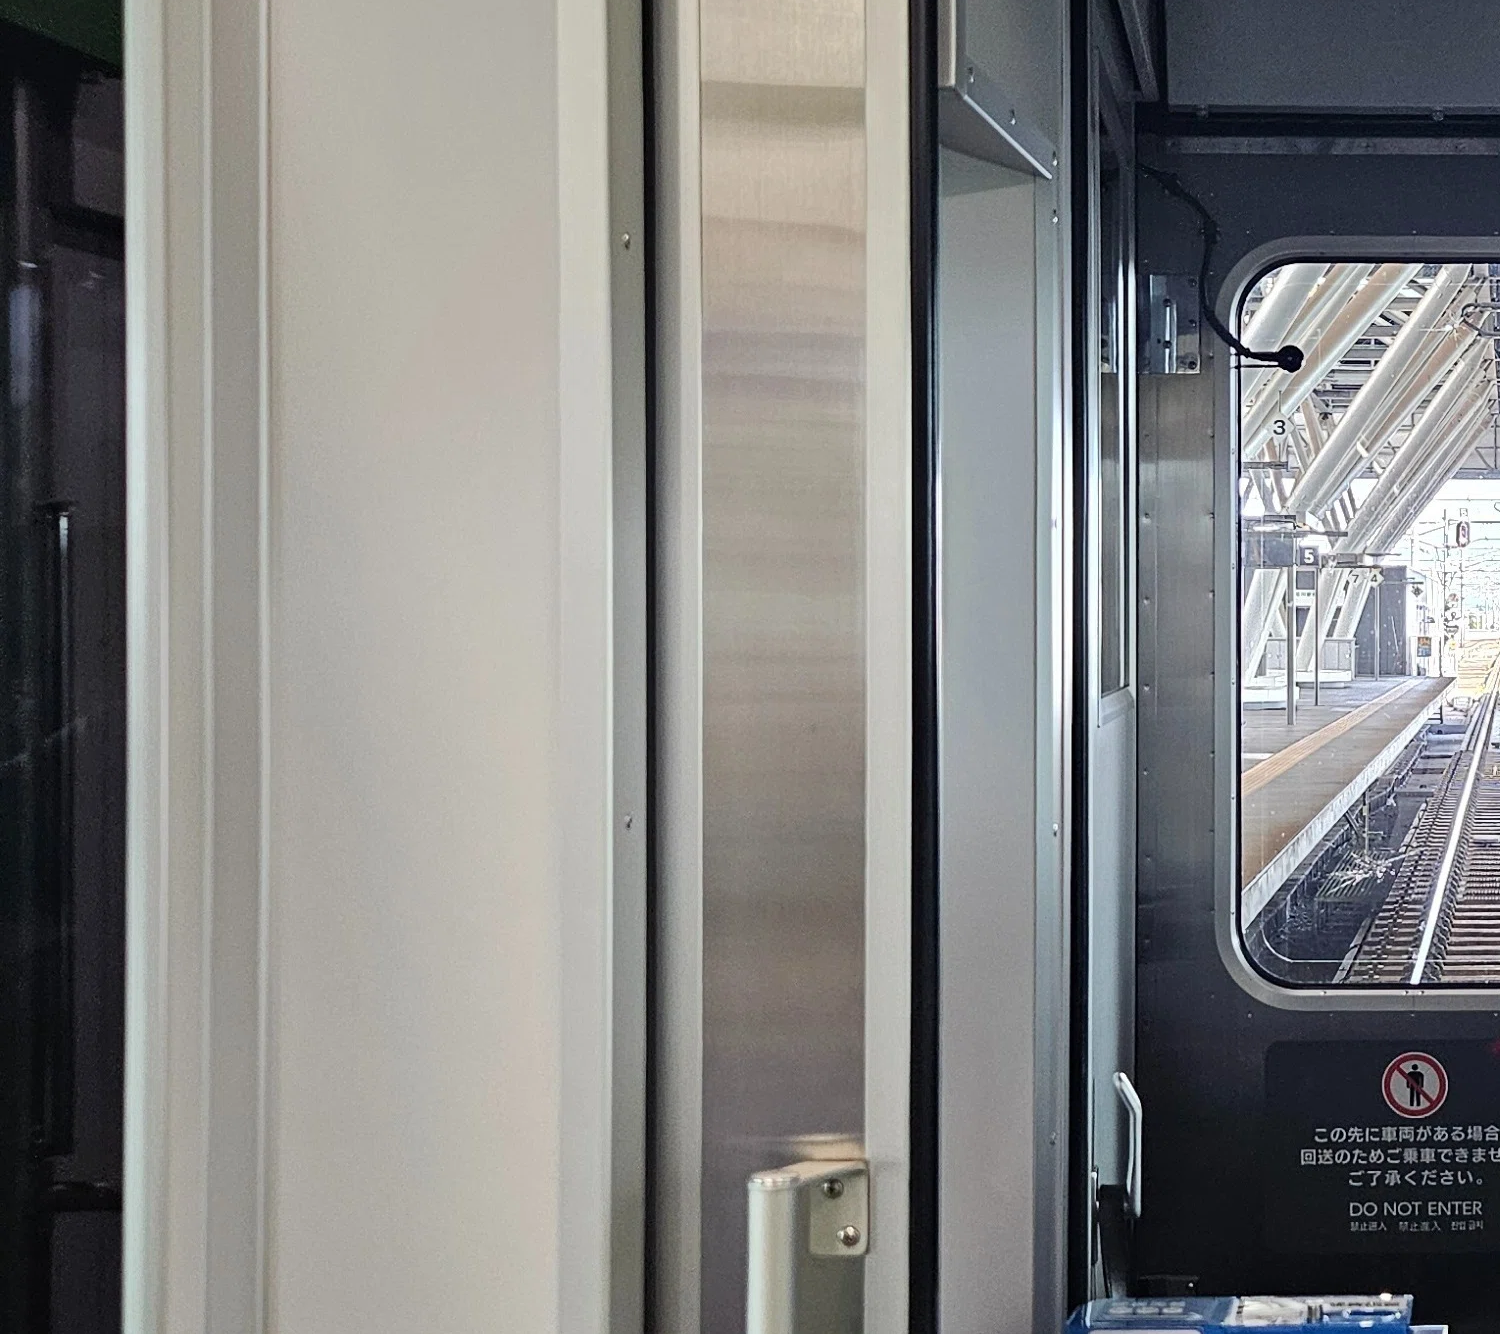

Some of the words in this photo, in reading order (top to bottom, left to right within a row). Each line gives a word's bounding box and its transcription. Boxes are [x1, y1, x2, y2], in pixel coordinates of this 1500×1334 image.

[1273, 419, 1286, 436] 3
[1304, 548, 1315, 564] 5
[1348, 1169, 1485, 1187] ご了承ください。
[1349, 1201, 1378, 1217] DO
[1383, 1201, 1423, 1217] NOT
[1427, 1200, 1484, 1216] ENTER
